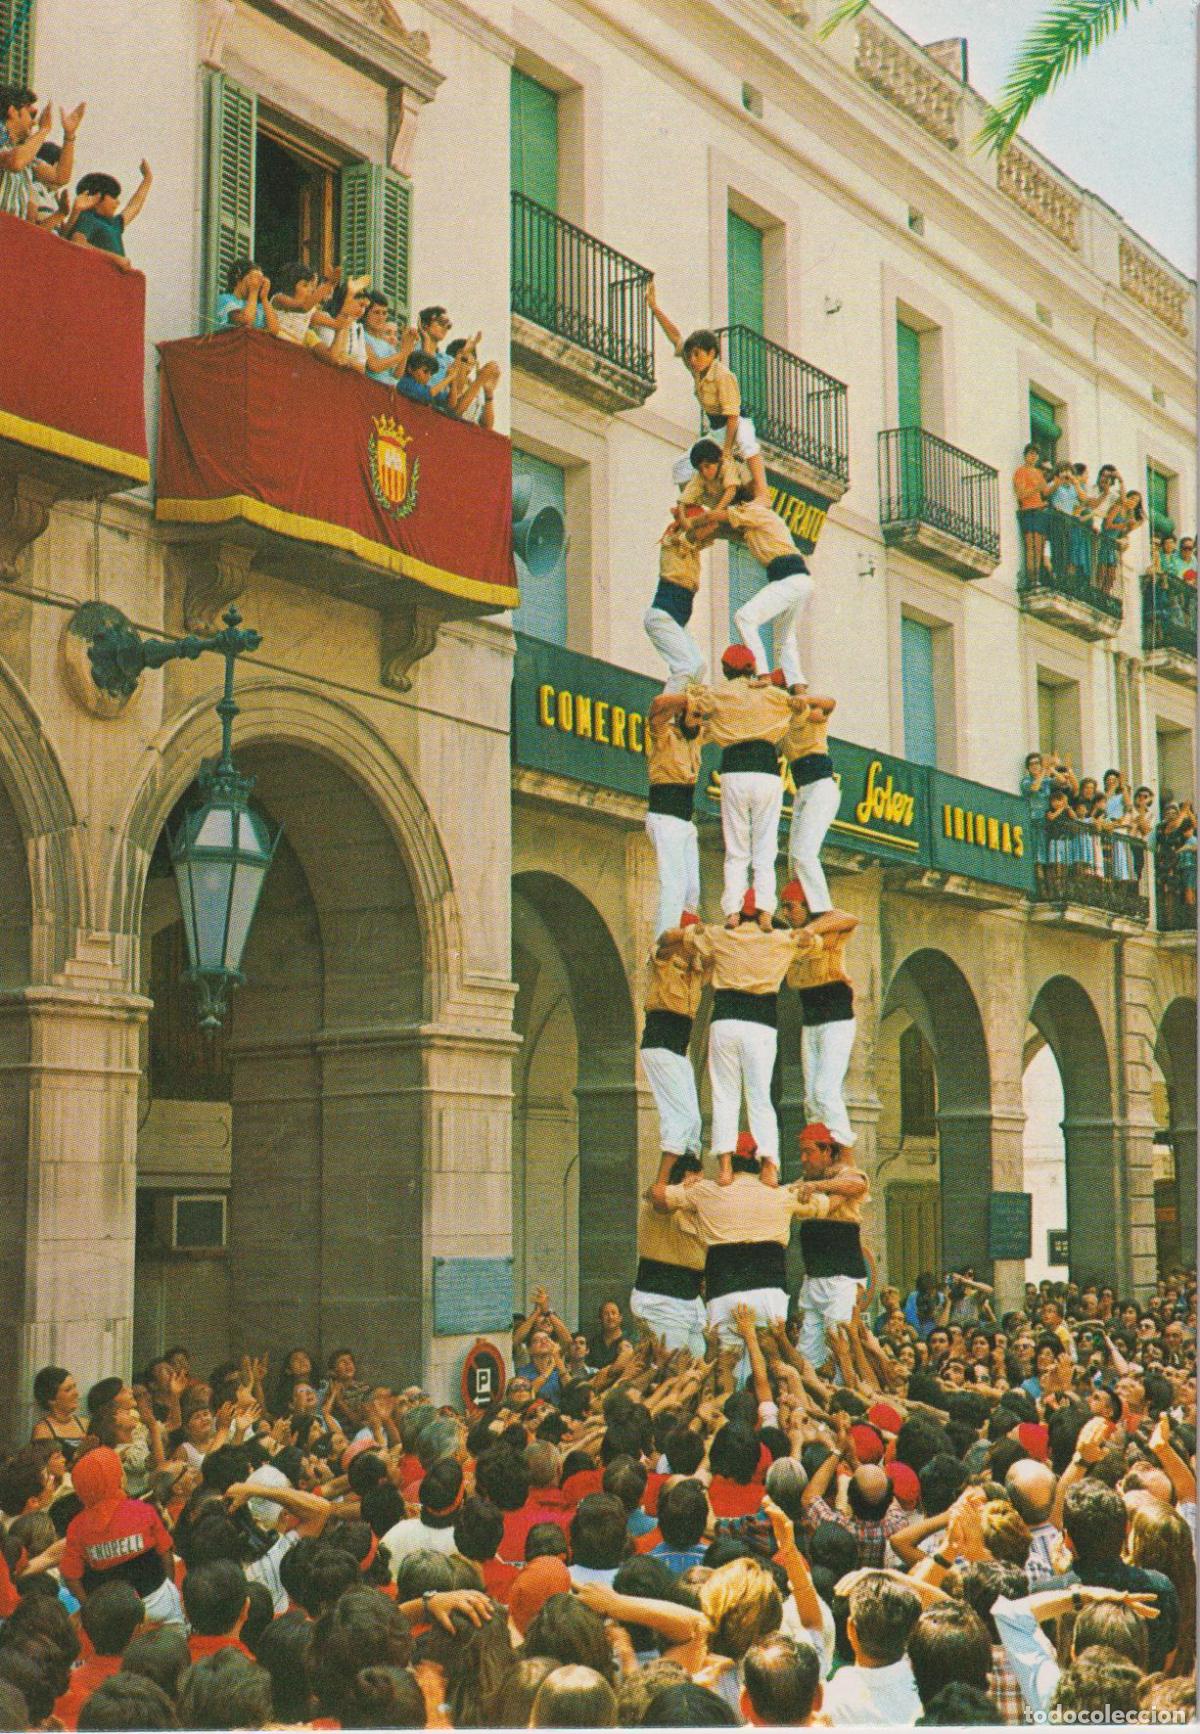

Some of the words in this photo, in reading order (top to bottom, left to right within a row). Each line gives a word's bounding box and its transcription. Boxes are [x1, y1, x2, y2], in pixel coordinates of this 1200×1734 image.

[539, 684, 653, 756] COMERCI
[943, 804, 1024, 858] IDIOMAS
[478, 1371, 488, 1390] P
